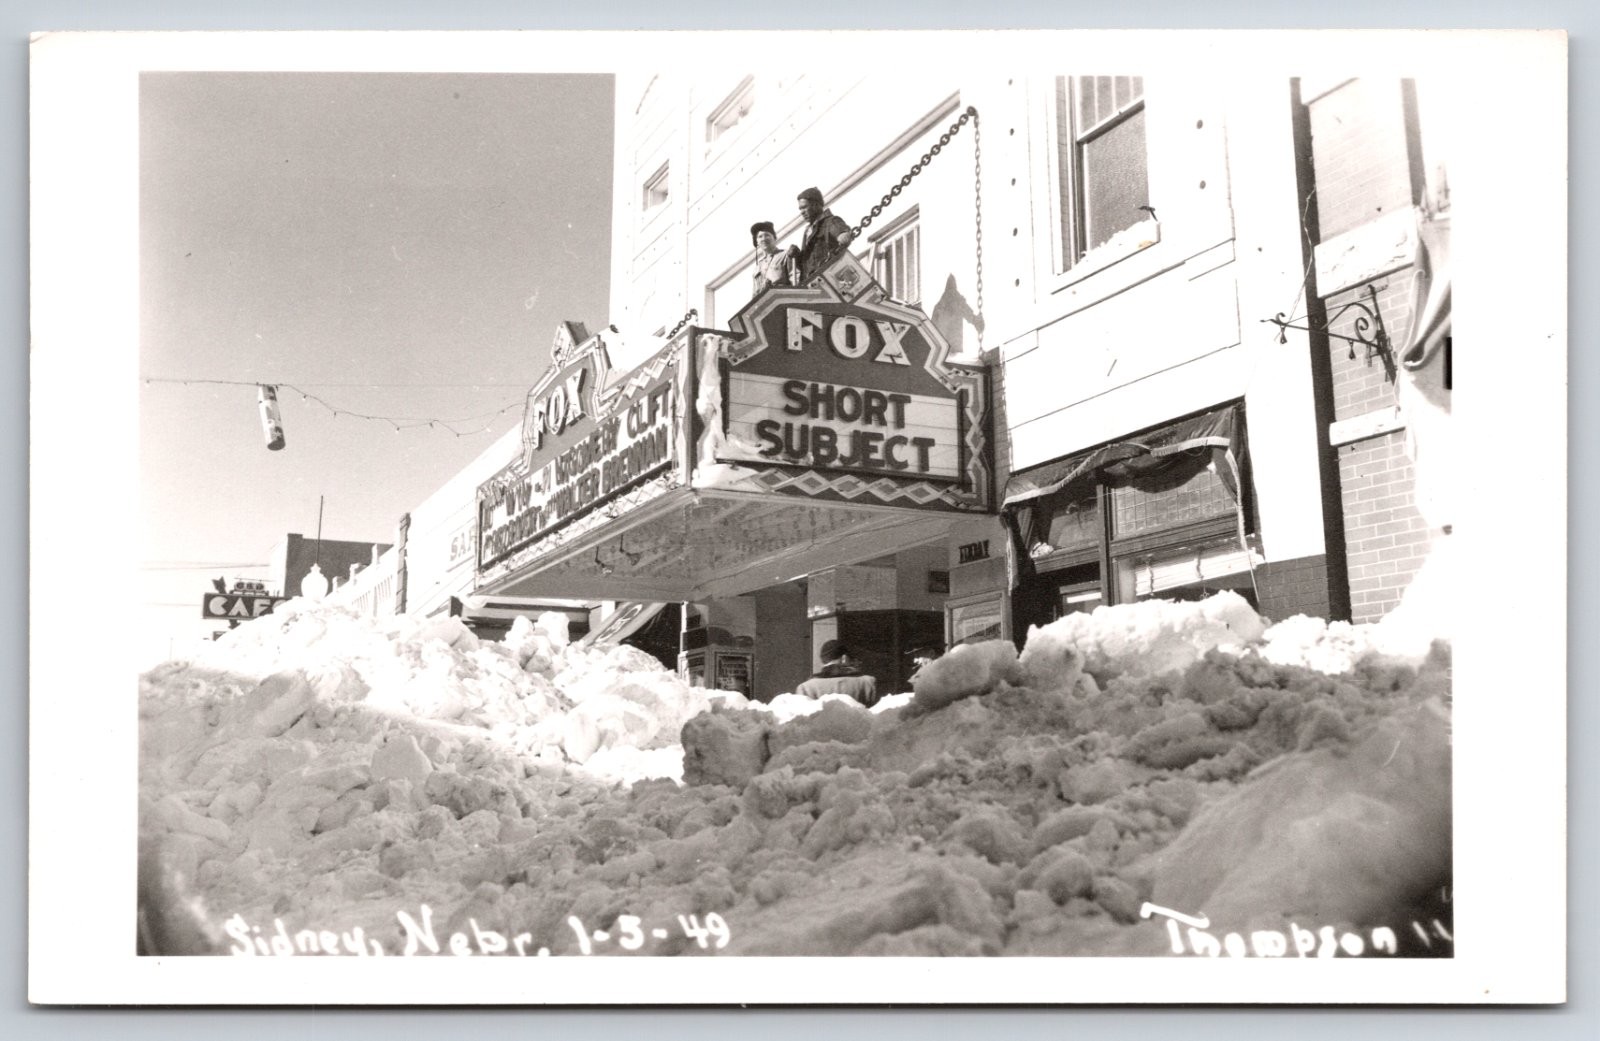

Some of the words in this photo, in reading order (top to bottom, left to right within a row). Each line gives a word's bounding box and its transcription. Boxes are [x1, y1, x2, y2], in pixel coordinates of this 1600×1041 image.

[786, 307, 912, 367] FOX
[530, 367, 587, 451] FOX
[782, 380, 912, 429] SHORT
[602, 423, 668, 496] BRENNAN
[757, 419, 936, 472] SUBJECT
[209, 596, 287, 617] CAF
